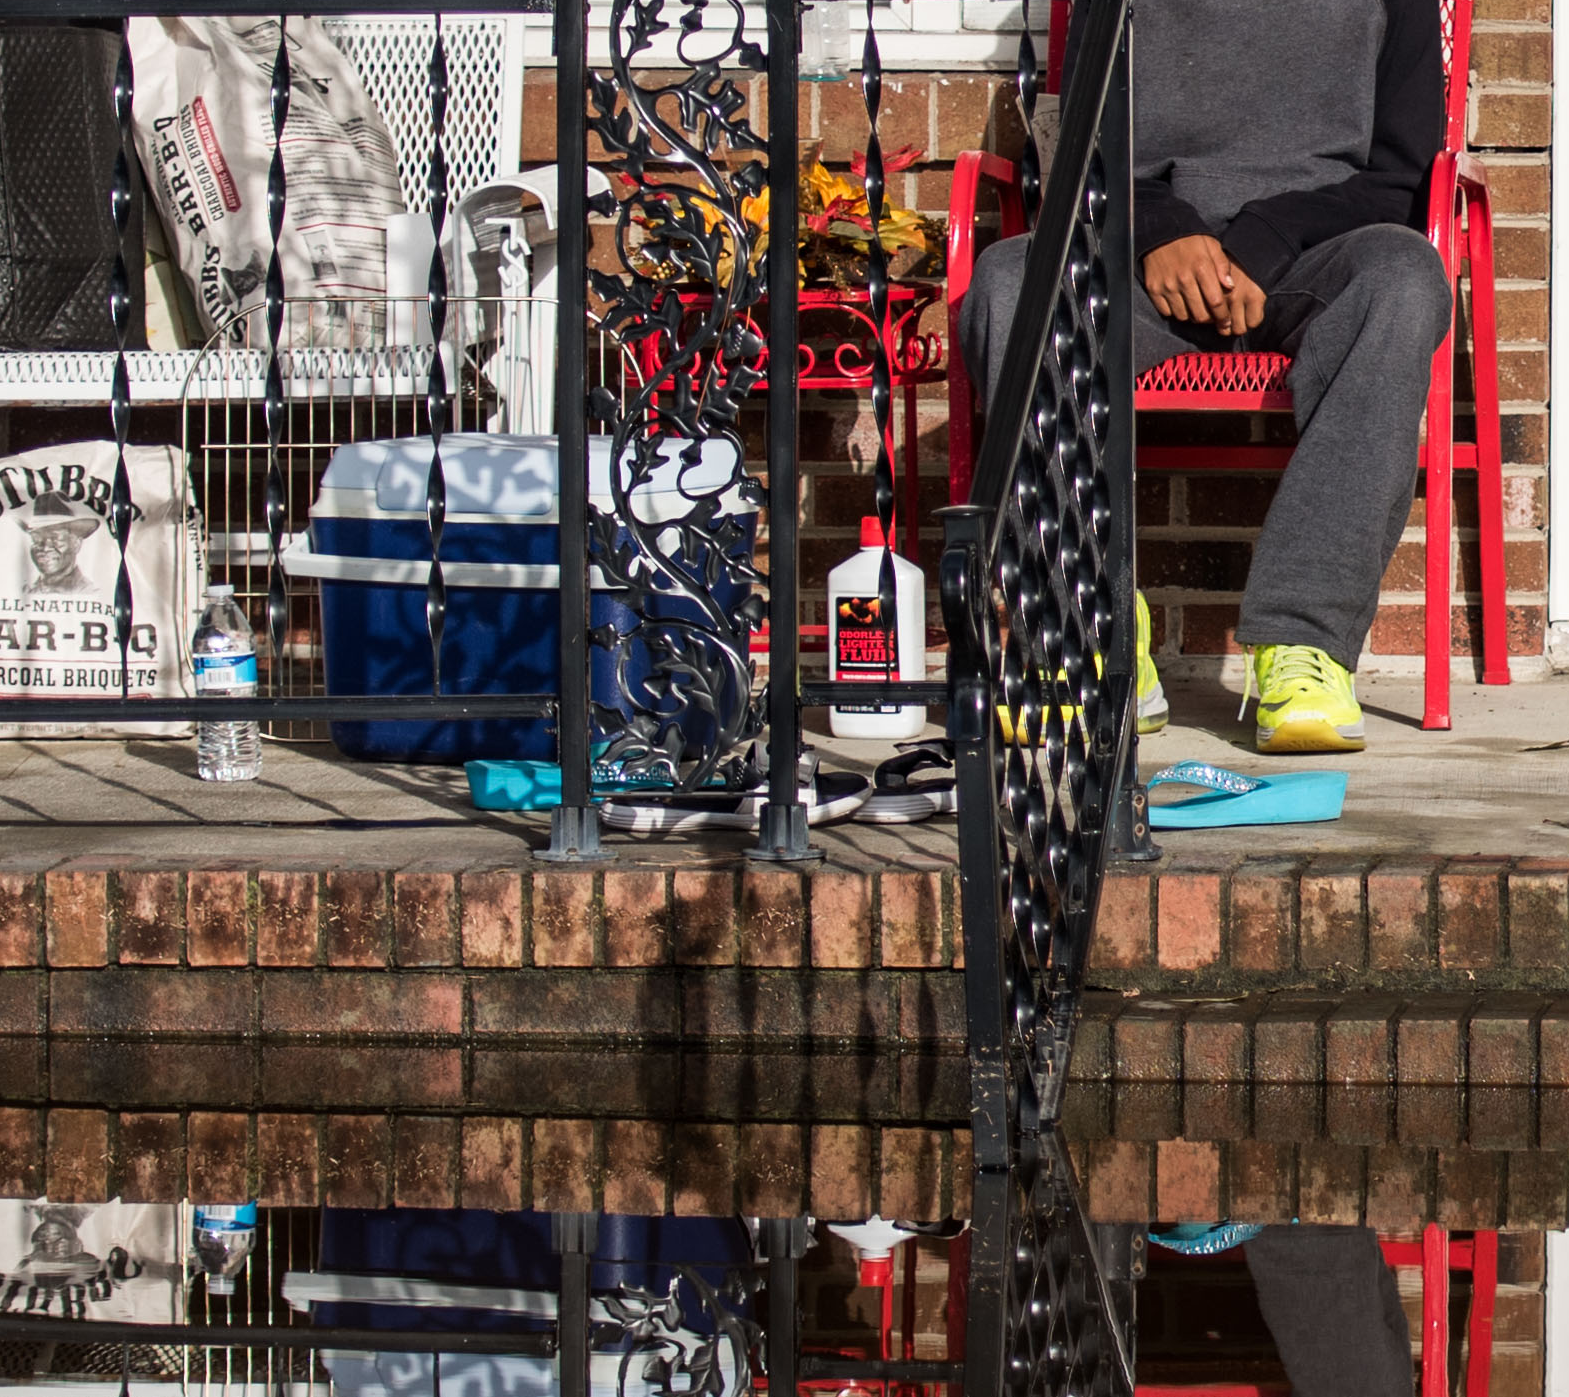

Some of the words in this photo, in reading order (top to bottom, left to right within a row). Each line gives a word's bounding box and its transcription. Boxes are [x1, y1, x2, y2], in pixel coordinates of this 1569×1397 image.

[153, 116, 207, 237] BAR-B-Q
[193, 159, 225, 221] CHARCOAL
[63, 668, 158, 691] BRIQUETS
